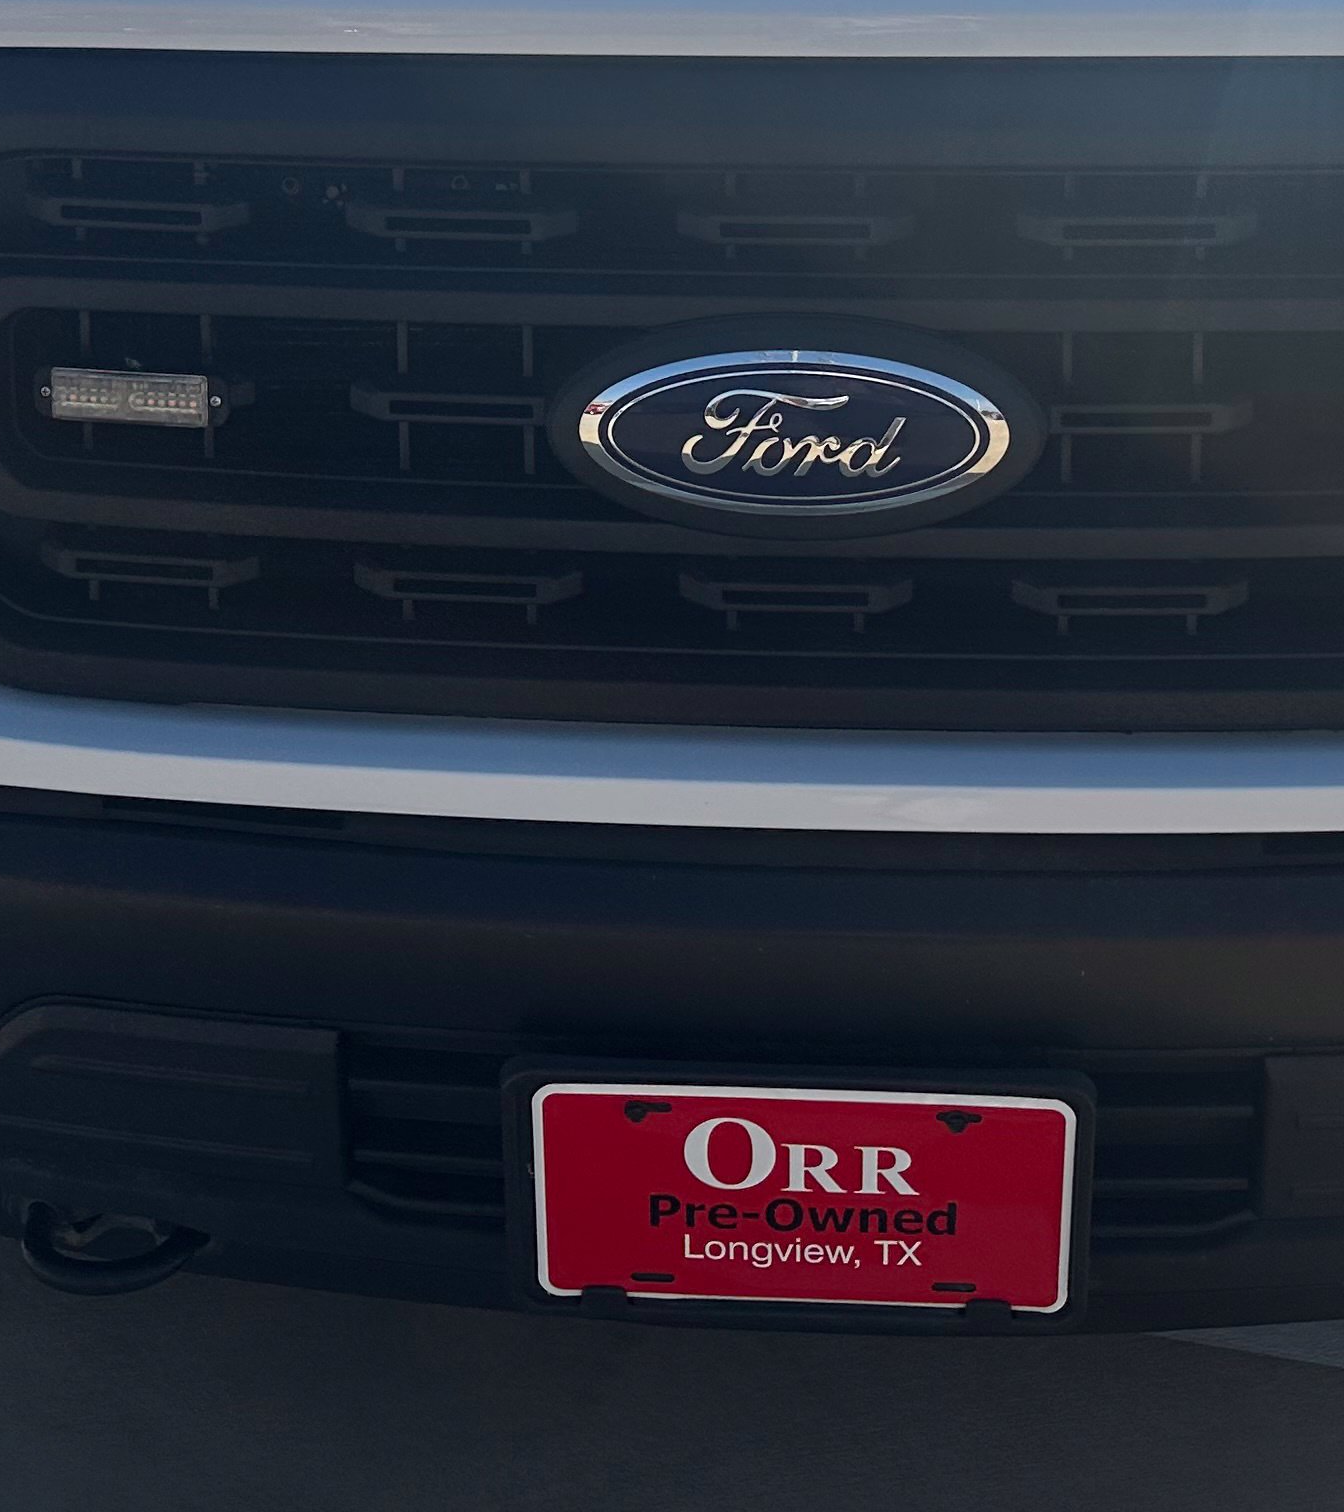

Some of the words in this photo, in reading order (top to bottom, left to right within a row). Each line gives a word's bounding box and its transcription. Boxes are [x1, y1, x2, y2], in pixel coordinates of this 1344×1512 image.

[681, 389, 907, 478] Ford
[648, 1194, 958, 1236] Pre-Owned
[683, 1234, 862, 1269] Longview,
[874, 1239, 923, 1267] TX
